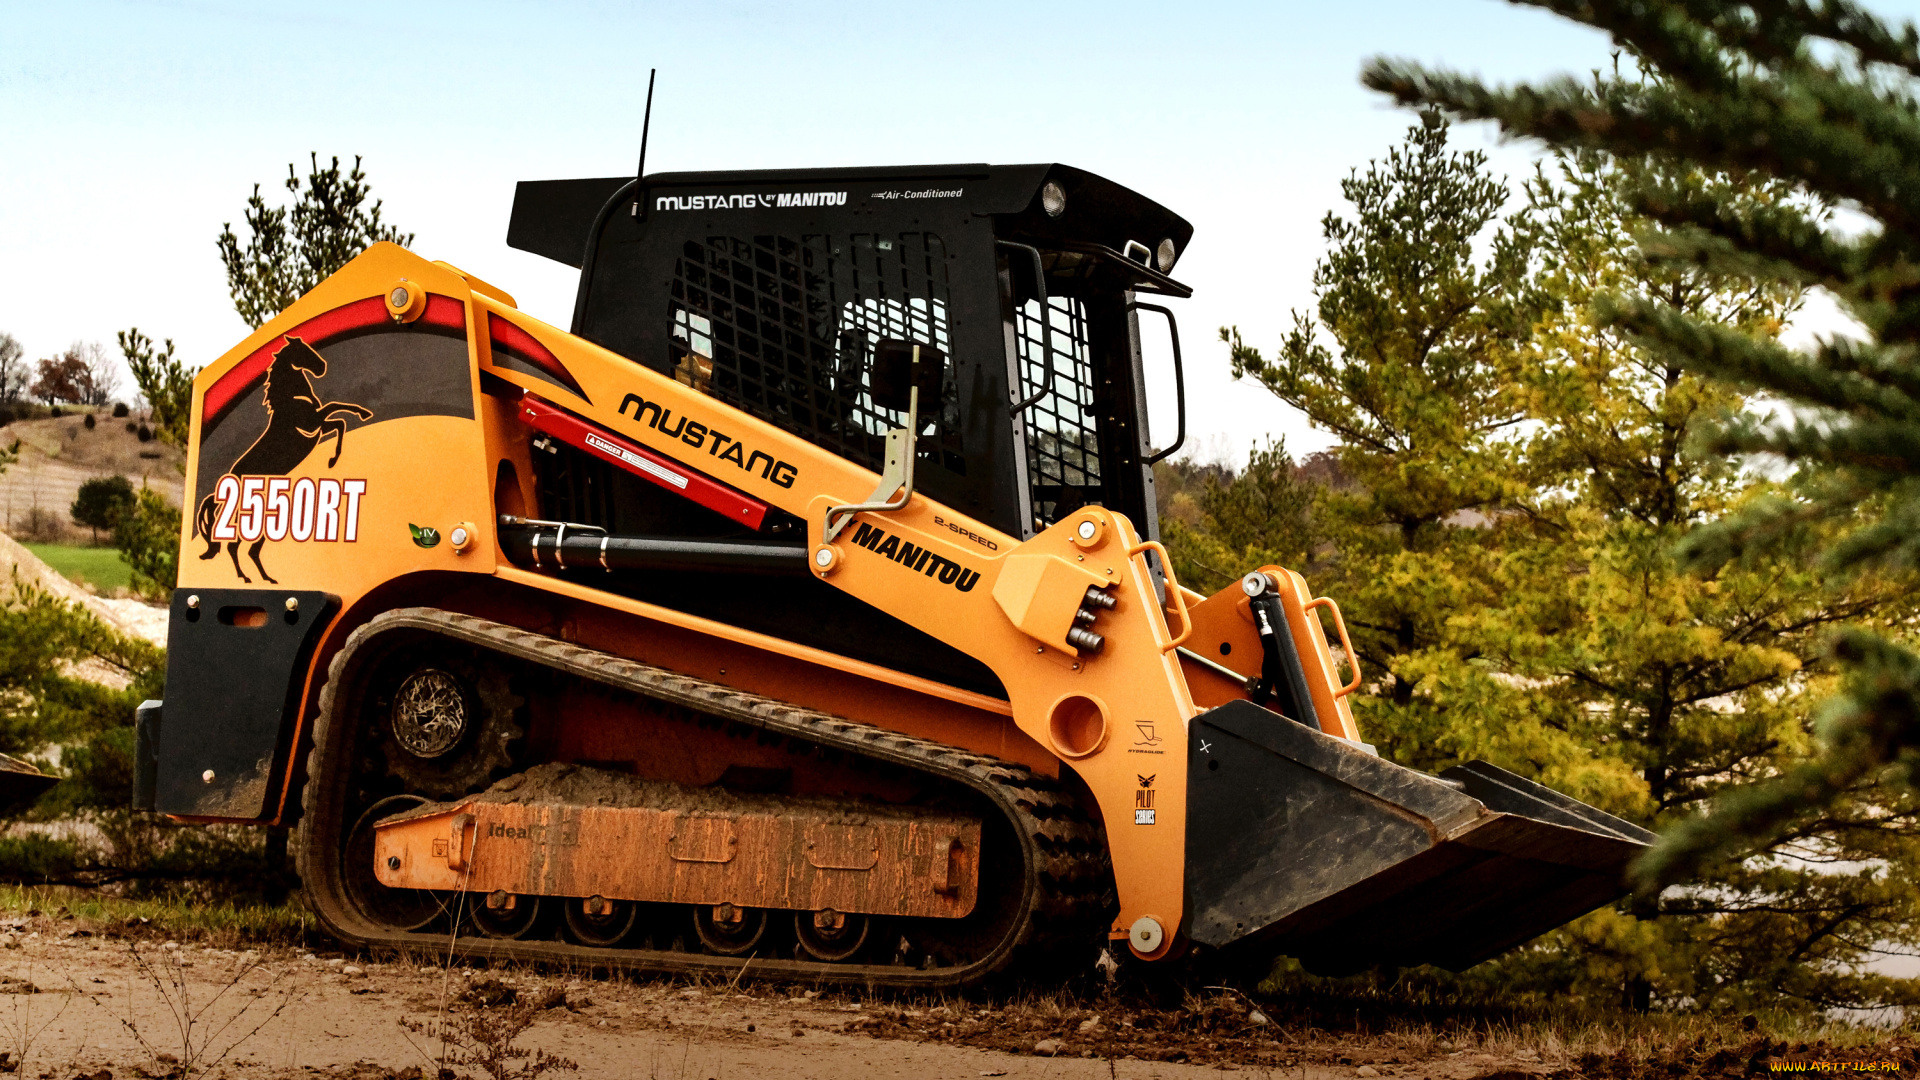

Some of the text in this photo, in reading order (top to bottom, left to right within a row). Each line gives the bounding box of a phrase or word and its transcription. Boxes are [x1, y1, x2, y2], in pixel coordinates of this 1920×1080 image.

[656, 194, 756, 211] MUSTANG
[776, 192, 847, 207] MANITOU
[885, 187, 963, 200] Air-Conditioned
[595, 439, 621, 456] DANGER
[618, 393, 798, 489] MUSTANG
[211, 476, 367, 543] 2550RT
[934, 516, 998, 551] 2-SPEED
[851, 522, 981, 592] MANITOU
[1135, 789, 1155, 808] PILOT
